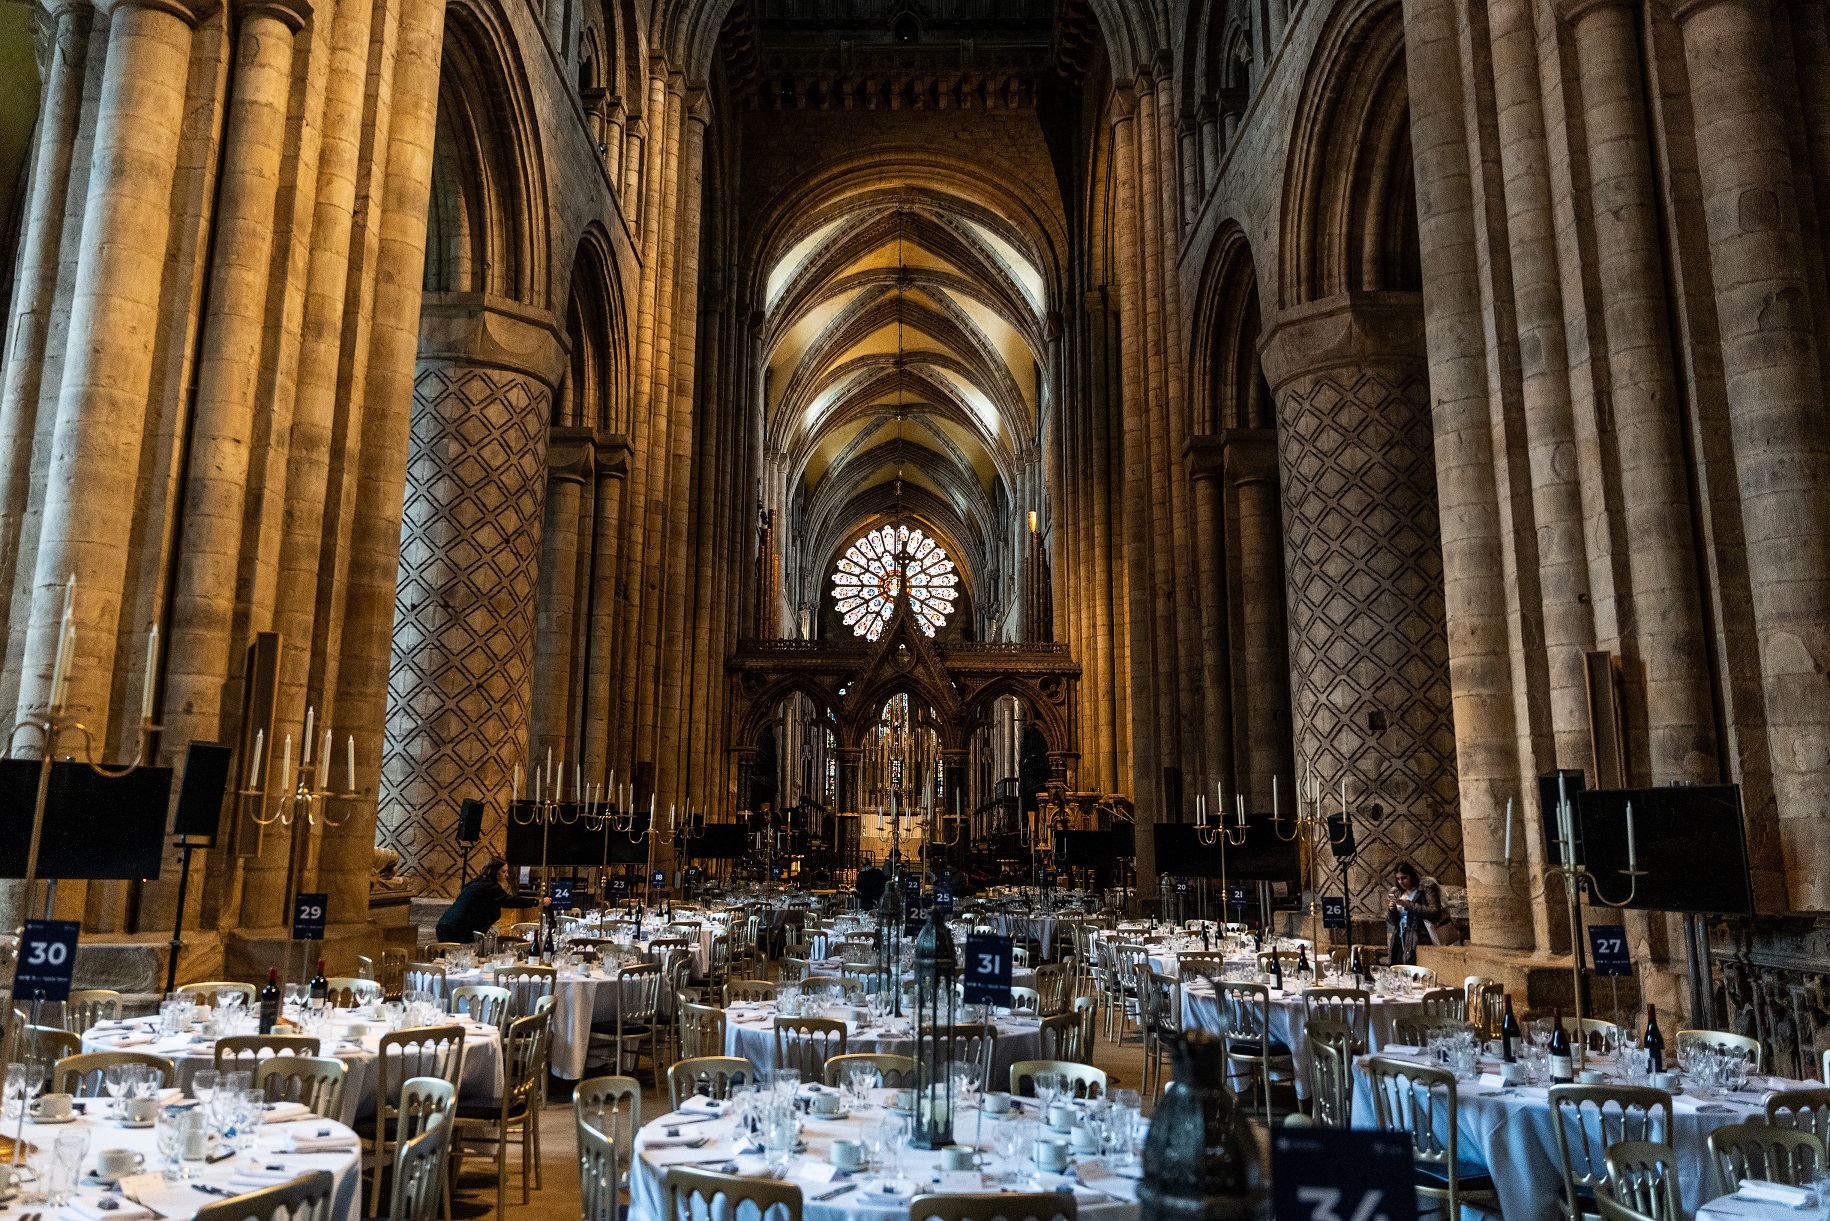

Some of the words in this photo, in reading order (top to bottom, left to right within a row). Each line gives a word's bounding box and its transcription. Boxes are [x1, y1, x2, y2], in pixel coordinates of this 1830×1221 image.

[613, 880, 625, 888] 23
[555, 888, 570, 898] 24
[936, 893, 950, 902] 25
[1234, 890, 1243, 898] 21
[300, 905, 322, 919] 29
[910, 907, 928, 919] 28
[1325, 905, 1342, 915] 26
[1596, 938, 1621, 953] 27
[27, 941, 68, 966] 30
[977, 953, 1001, 975] 31
